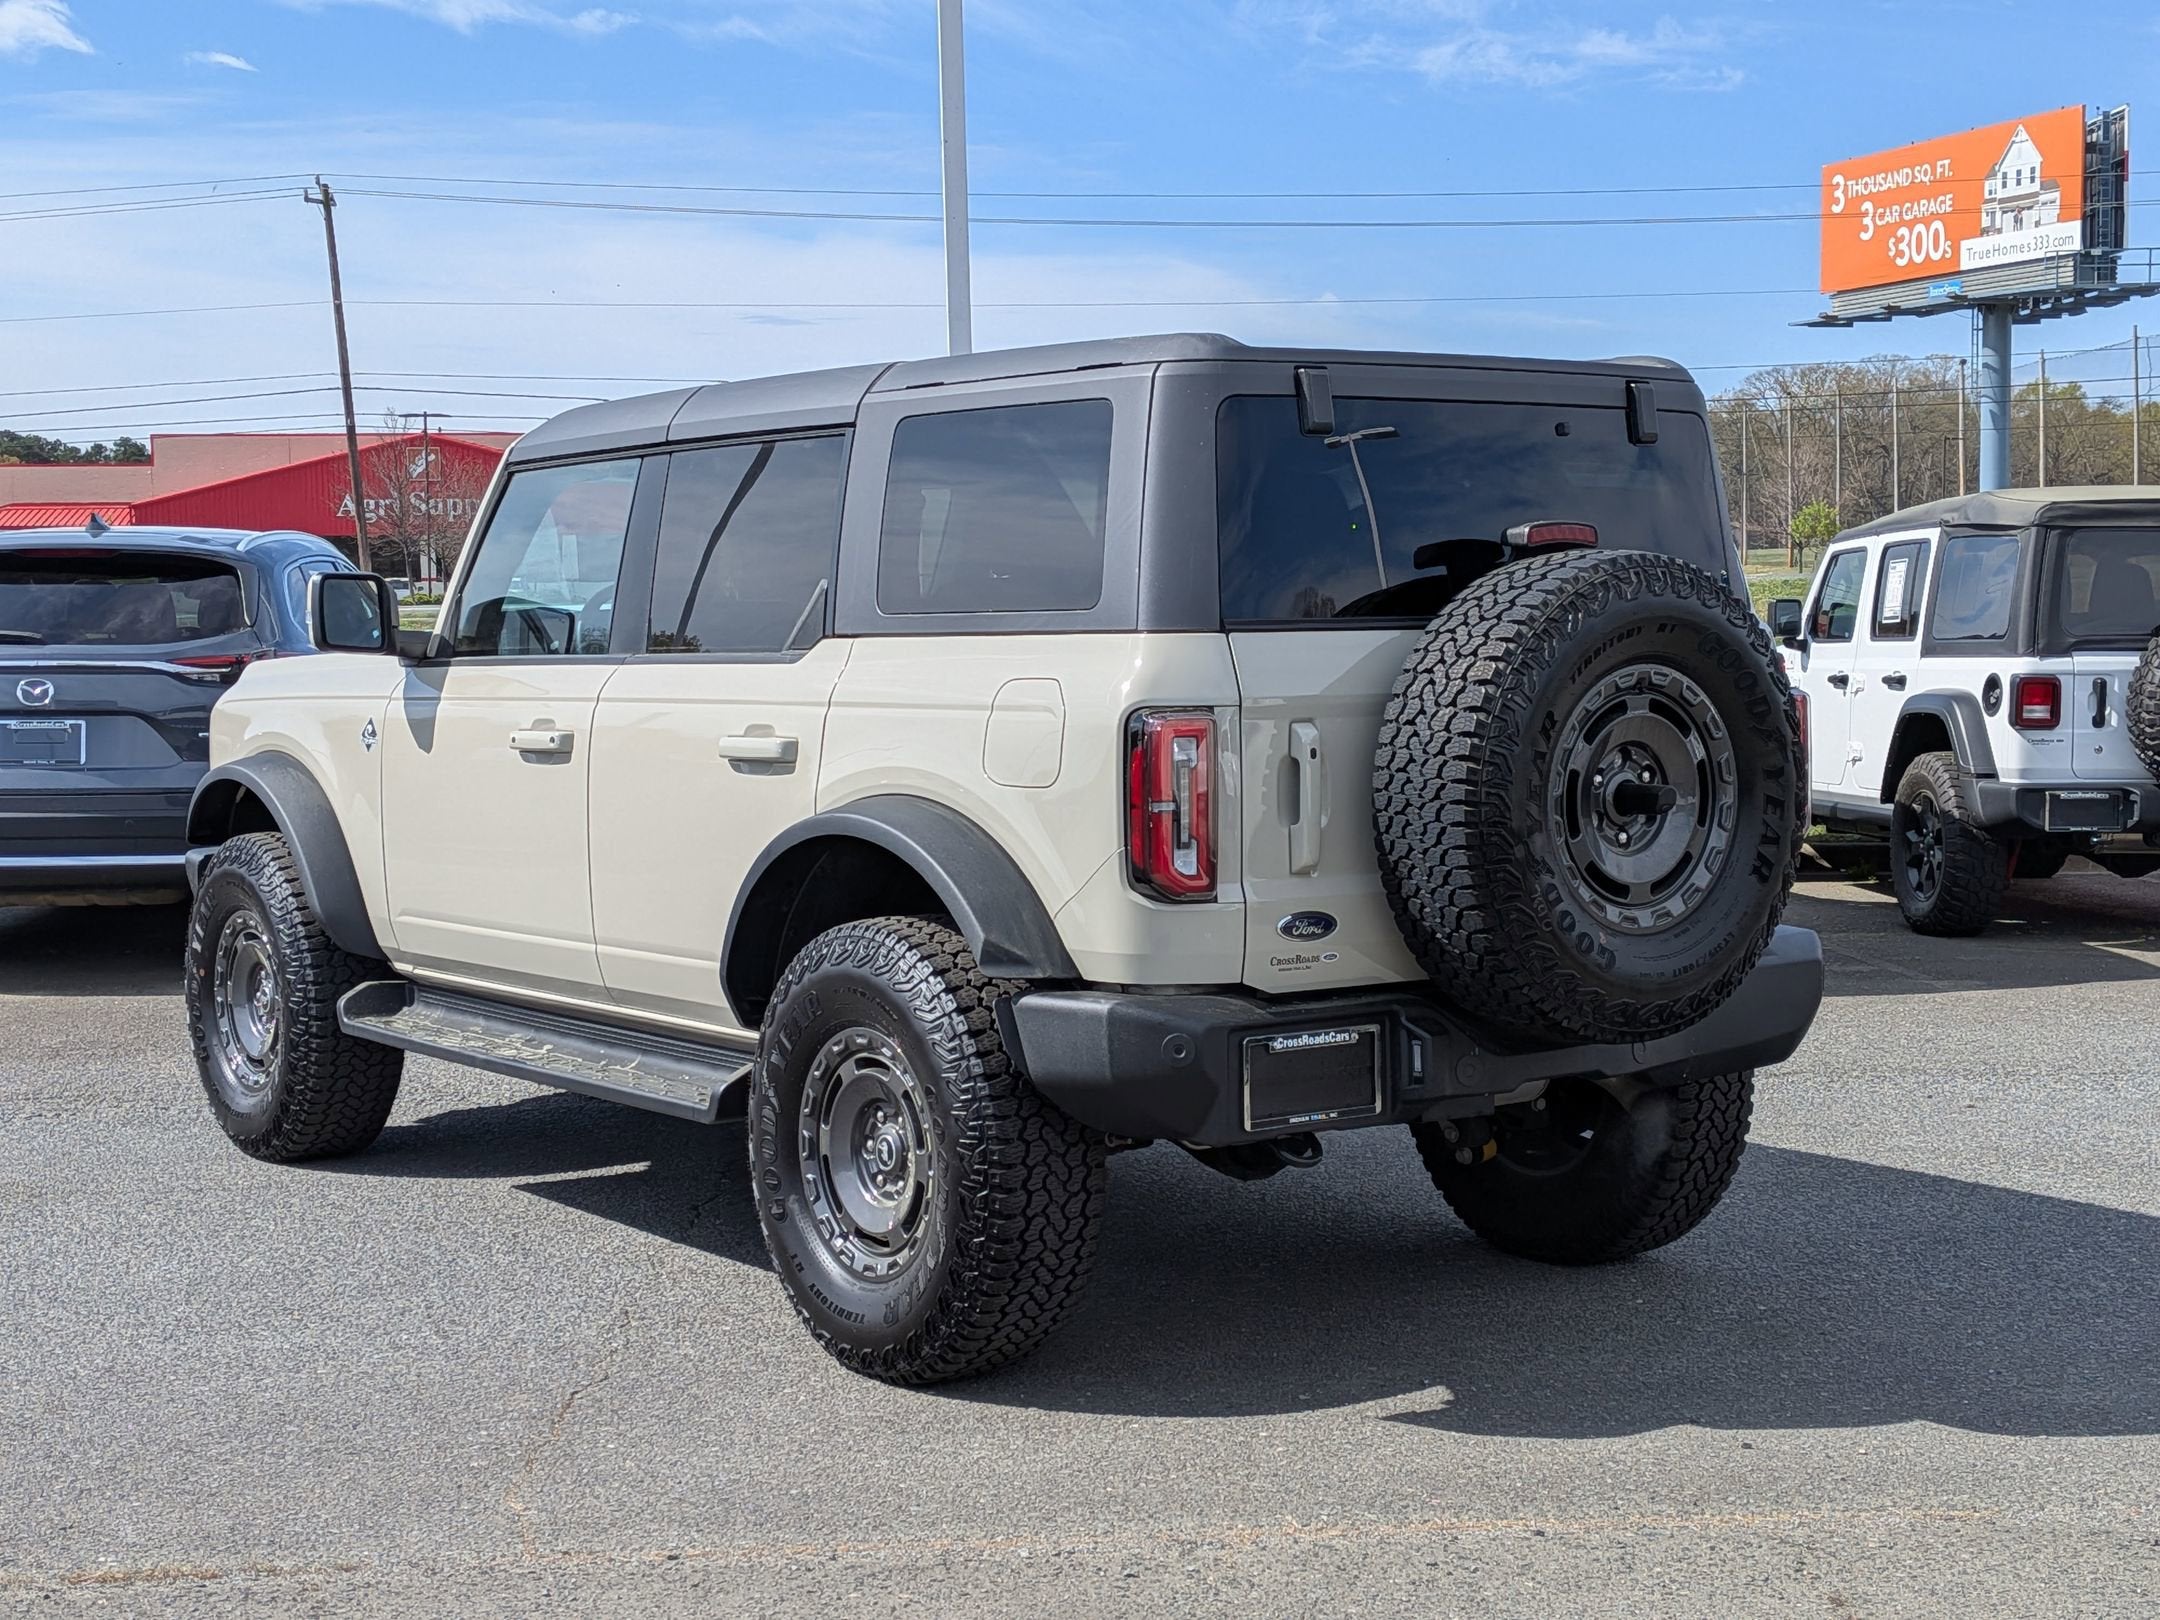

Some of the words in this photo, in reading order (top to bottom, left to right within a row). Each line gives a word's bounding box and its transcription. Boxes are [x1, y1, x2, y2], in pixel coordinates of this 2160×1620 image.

[1831, 174, 1846, 214] 3
[1846, 167, 1912, 199] THOUSAND
[1914, 163, 1934, 186] SQ.
[1936, 159, 1953, 179] FT.
[1859, 201, 1875, 241] 3
[1875, 205, 1901, 226] CAR
[1902, 193, 1954, 221] GARAGE
[1966, 234, 2075, 261] TrueHomes333.com
[1292, 919, 1325, 935] Ford
[807, 1281, 867, 1326] TERRITORY
